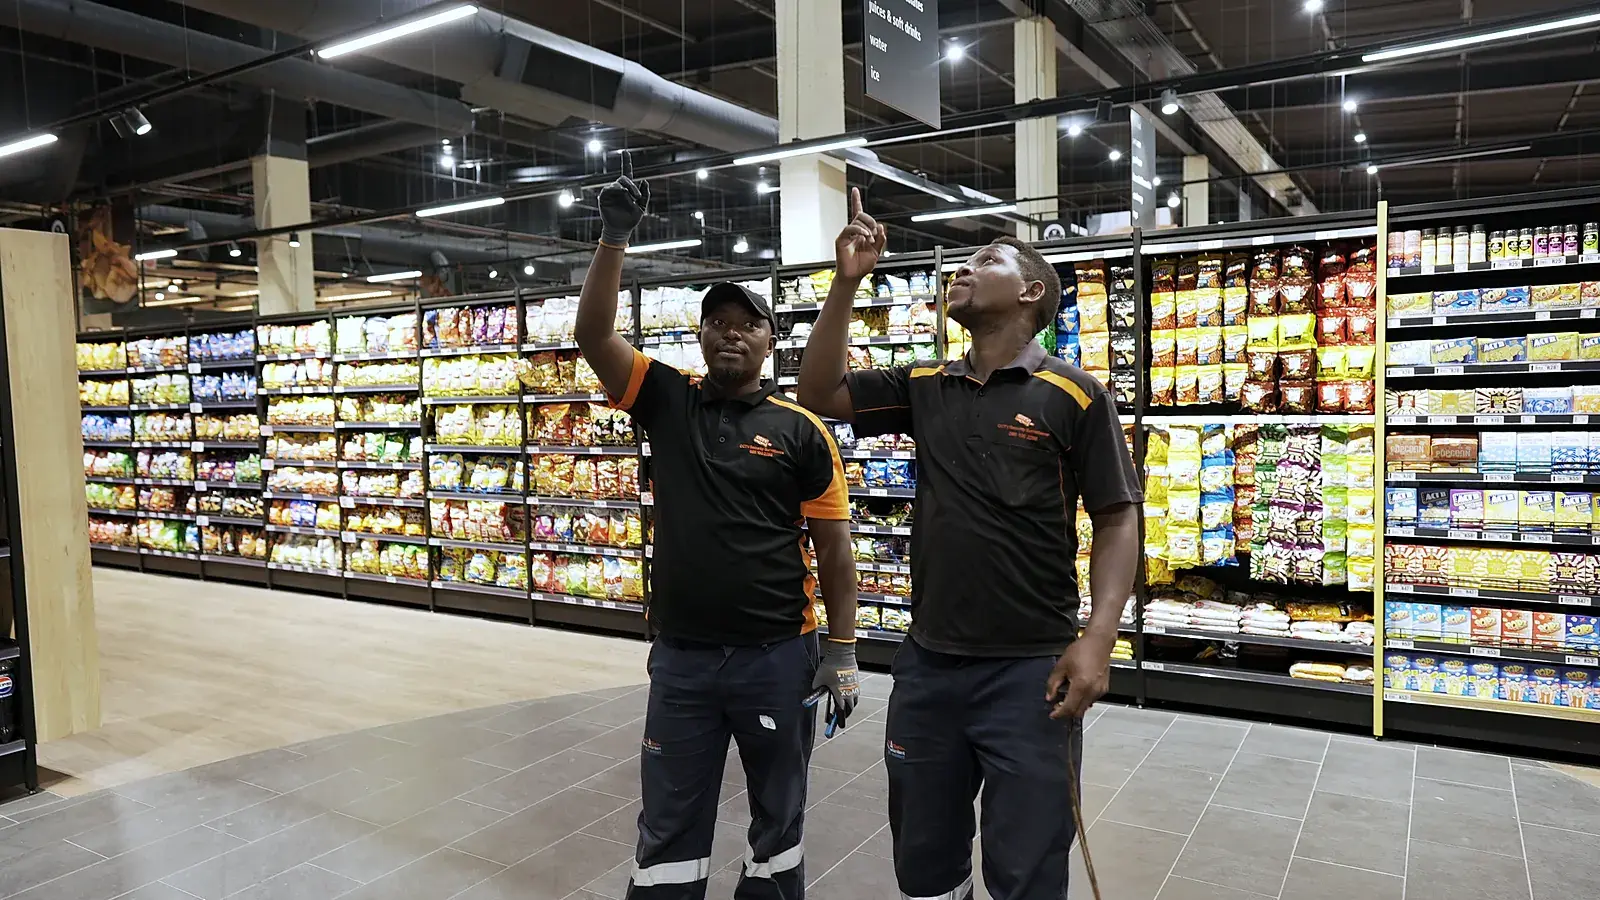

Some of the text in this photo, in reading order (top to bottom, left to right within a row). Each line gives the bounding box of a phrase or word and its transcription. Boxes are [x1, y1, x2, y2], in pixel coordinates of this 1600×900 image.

[868, 1, 887, 20] juices
[887, 9, 892, 24] &
[892, 16, 904, 31] soft
[904, 21, 922, 41] drinks
[870, 34, 888, 52] water
[870, 65, 880, 82] ice
[1425, 492, 1440, 501] ACT
